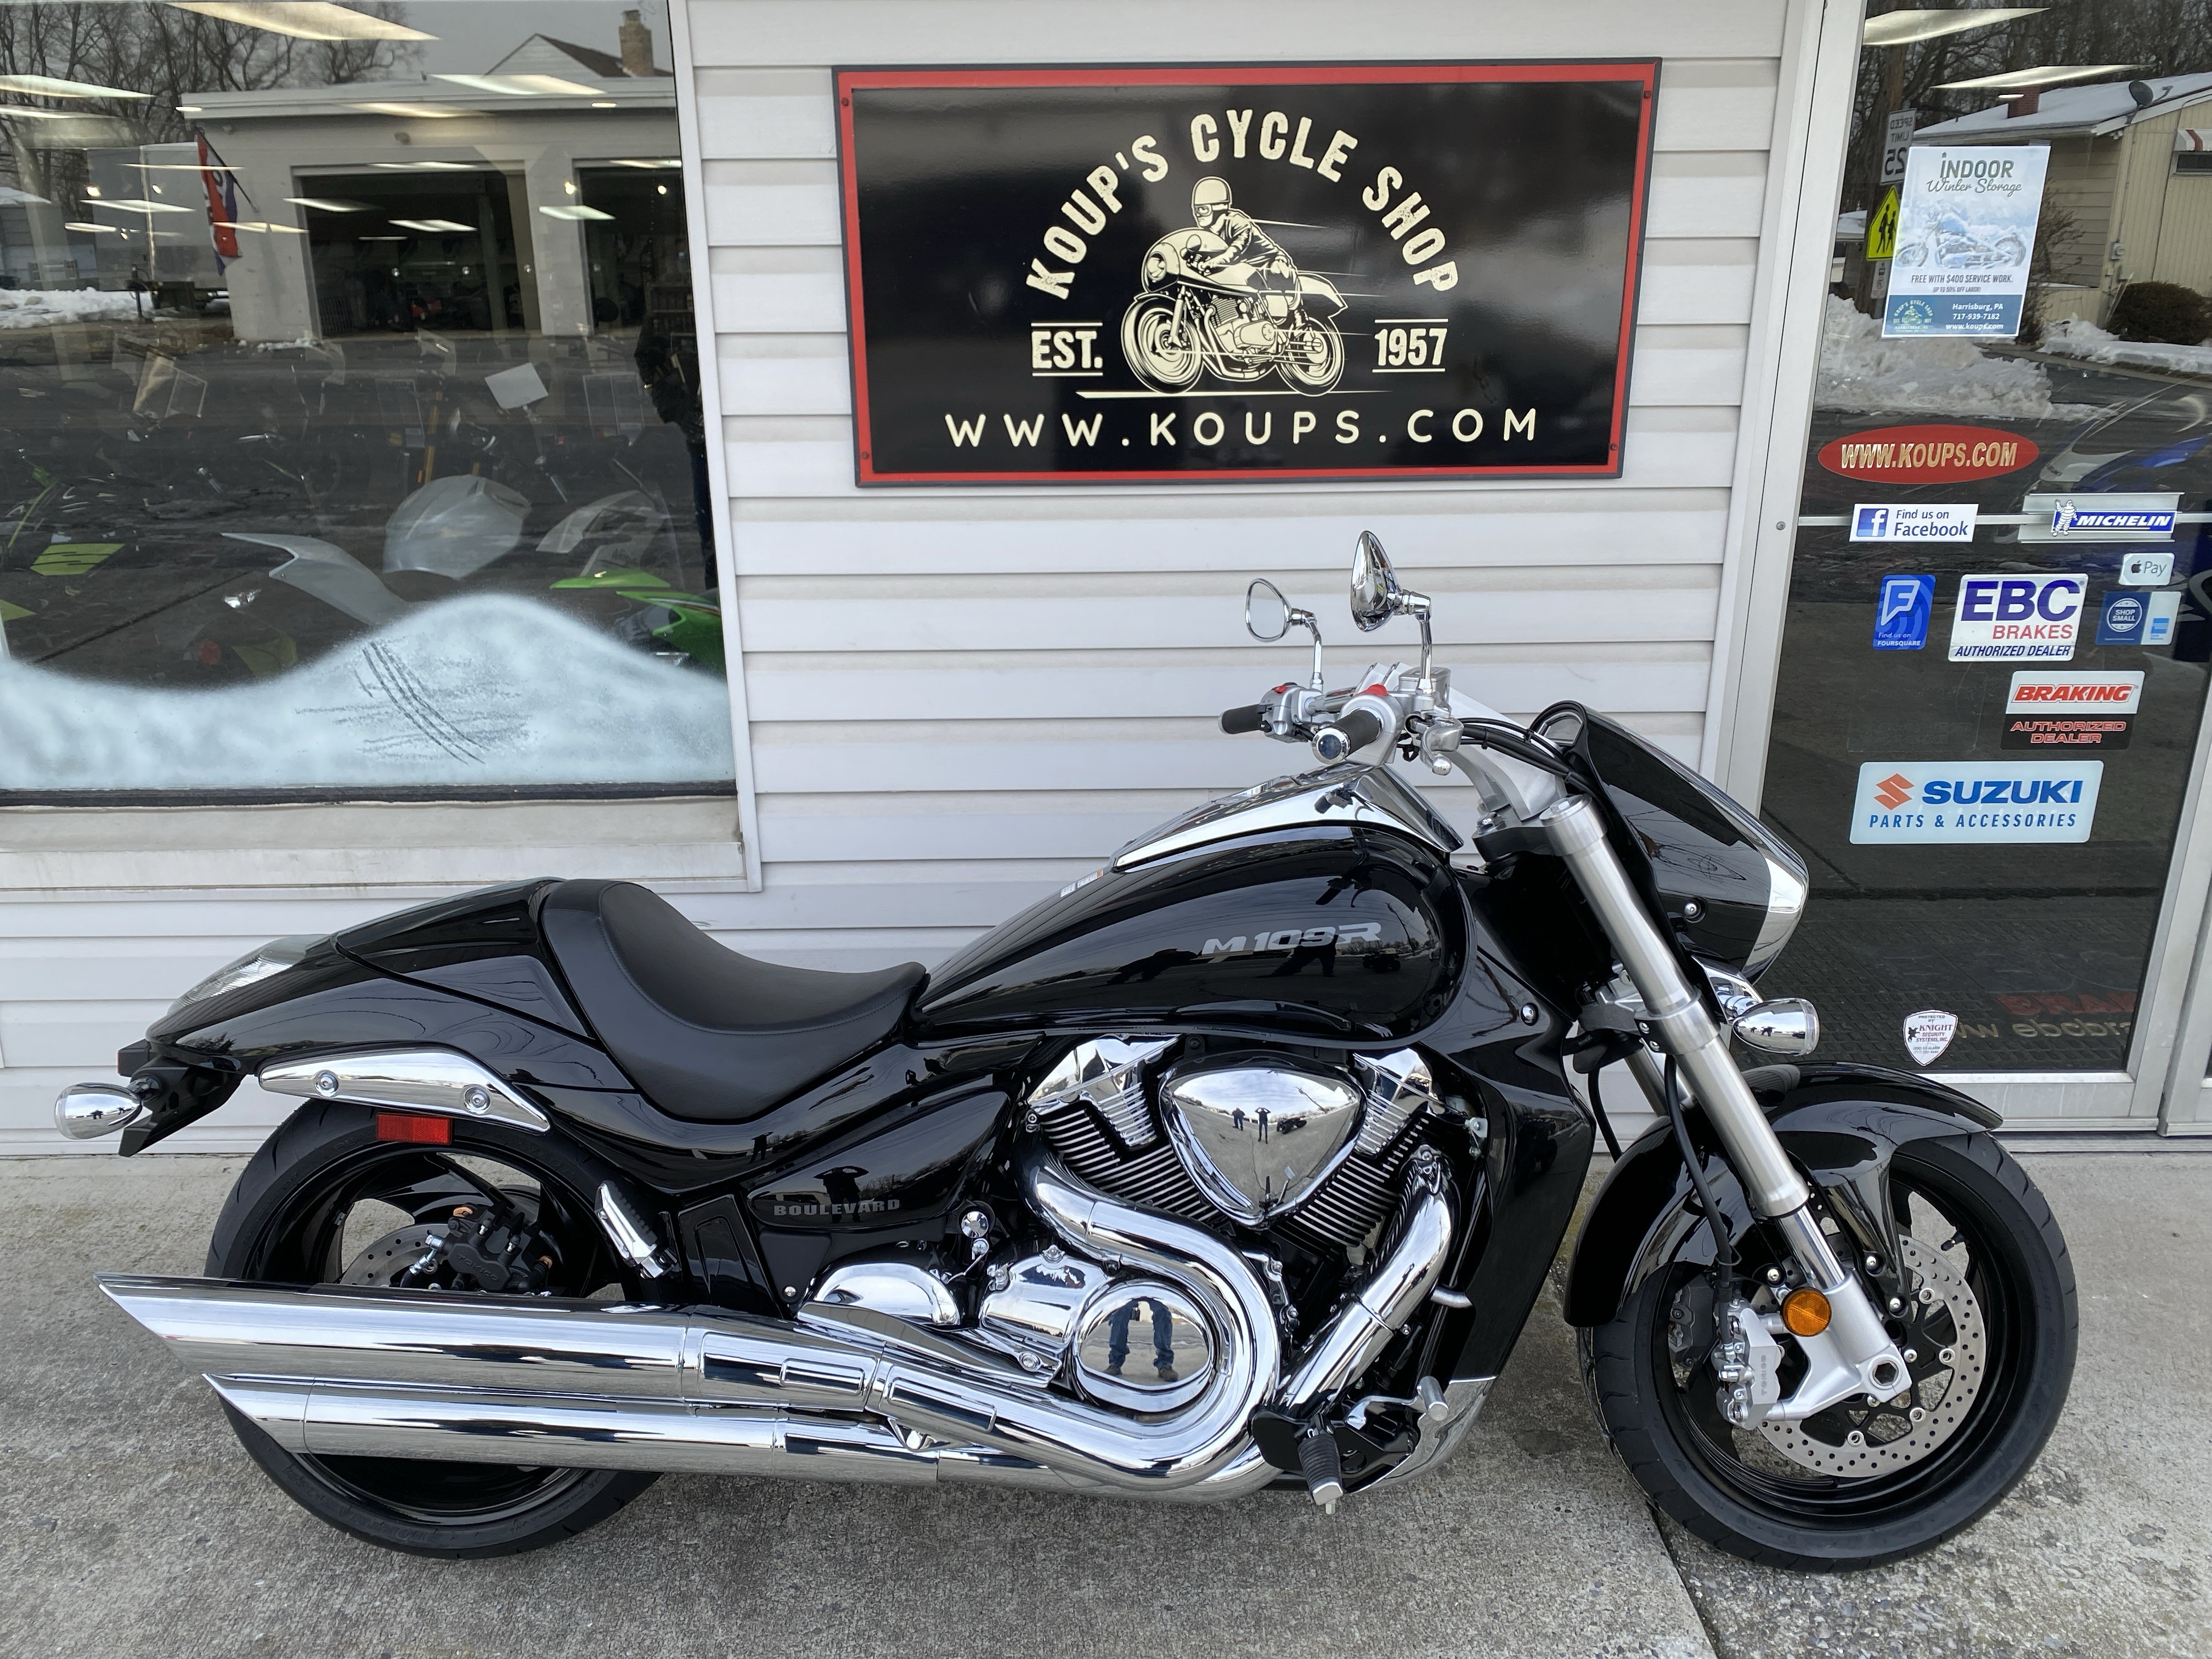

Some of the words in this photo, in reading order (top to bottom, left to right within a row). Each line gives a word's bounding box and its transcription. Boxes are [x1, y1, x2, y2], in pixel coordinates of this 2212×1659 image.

[1926, 177, 1972, 192] Winter
[1975, 178, 2023, 197] Storage
[1026, 135, 1169, 301] KOUP'S
[1190, 108, 1359, 183] CYCLE
[1362, 165, 1458, 294] SHOP
[1911, 275, 1927, 283] FREE
[1929, 275, 1944, 283] WITH
[1947, 275, 1963, 284] $400
[1965, 275, 1991, 283] SERVICE
[1952, 303, 1993, 311] Harrisburg,
[1945, 323, 2004, 331] www.koups.com
[1031, 330, 1103, 371] EST.
[1376, 326, 1448, 367] 1957
[945, 407, 1537, 448] WWW.KOUPS.COM
[1841, 442, 2018, 469] WWW.KOUPS.COM
[1896, 509, 1918, 519] Find
[1922, 511, 1933, 519] us
[1937, 511, 1949, 519] on
[2076, 516, 2171, 527] MICHELIN
[1894, 521, 1968, 536] Facebook
[2143, 561, 2168, 577] Pay
[1961, 579, 2080, 622] EBC
[1992, 624, 2073, 639] BRAKES
[1955, 646, 2025, 657] AUTHORIZED
[2027, 646, 2072, 656] DEALER
[2011, 684, 2135, 703] BRAKING
[2010, 721, 2127, 731] AUTHORIZED
[2030, 733, 2102, 743] DEALER
[1922, 780, 2084, 804] SUZUKI
[1869, 815, 1924, 828] PARTS
[1934, 815, 1944, 827] &
[1956, 814, 2076, 827] ACCESSORIES
[1202, 922, 1381, 955] M109R
[774, 1199, 900, 1216] BOULEVARD
